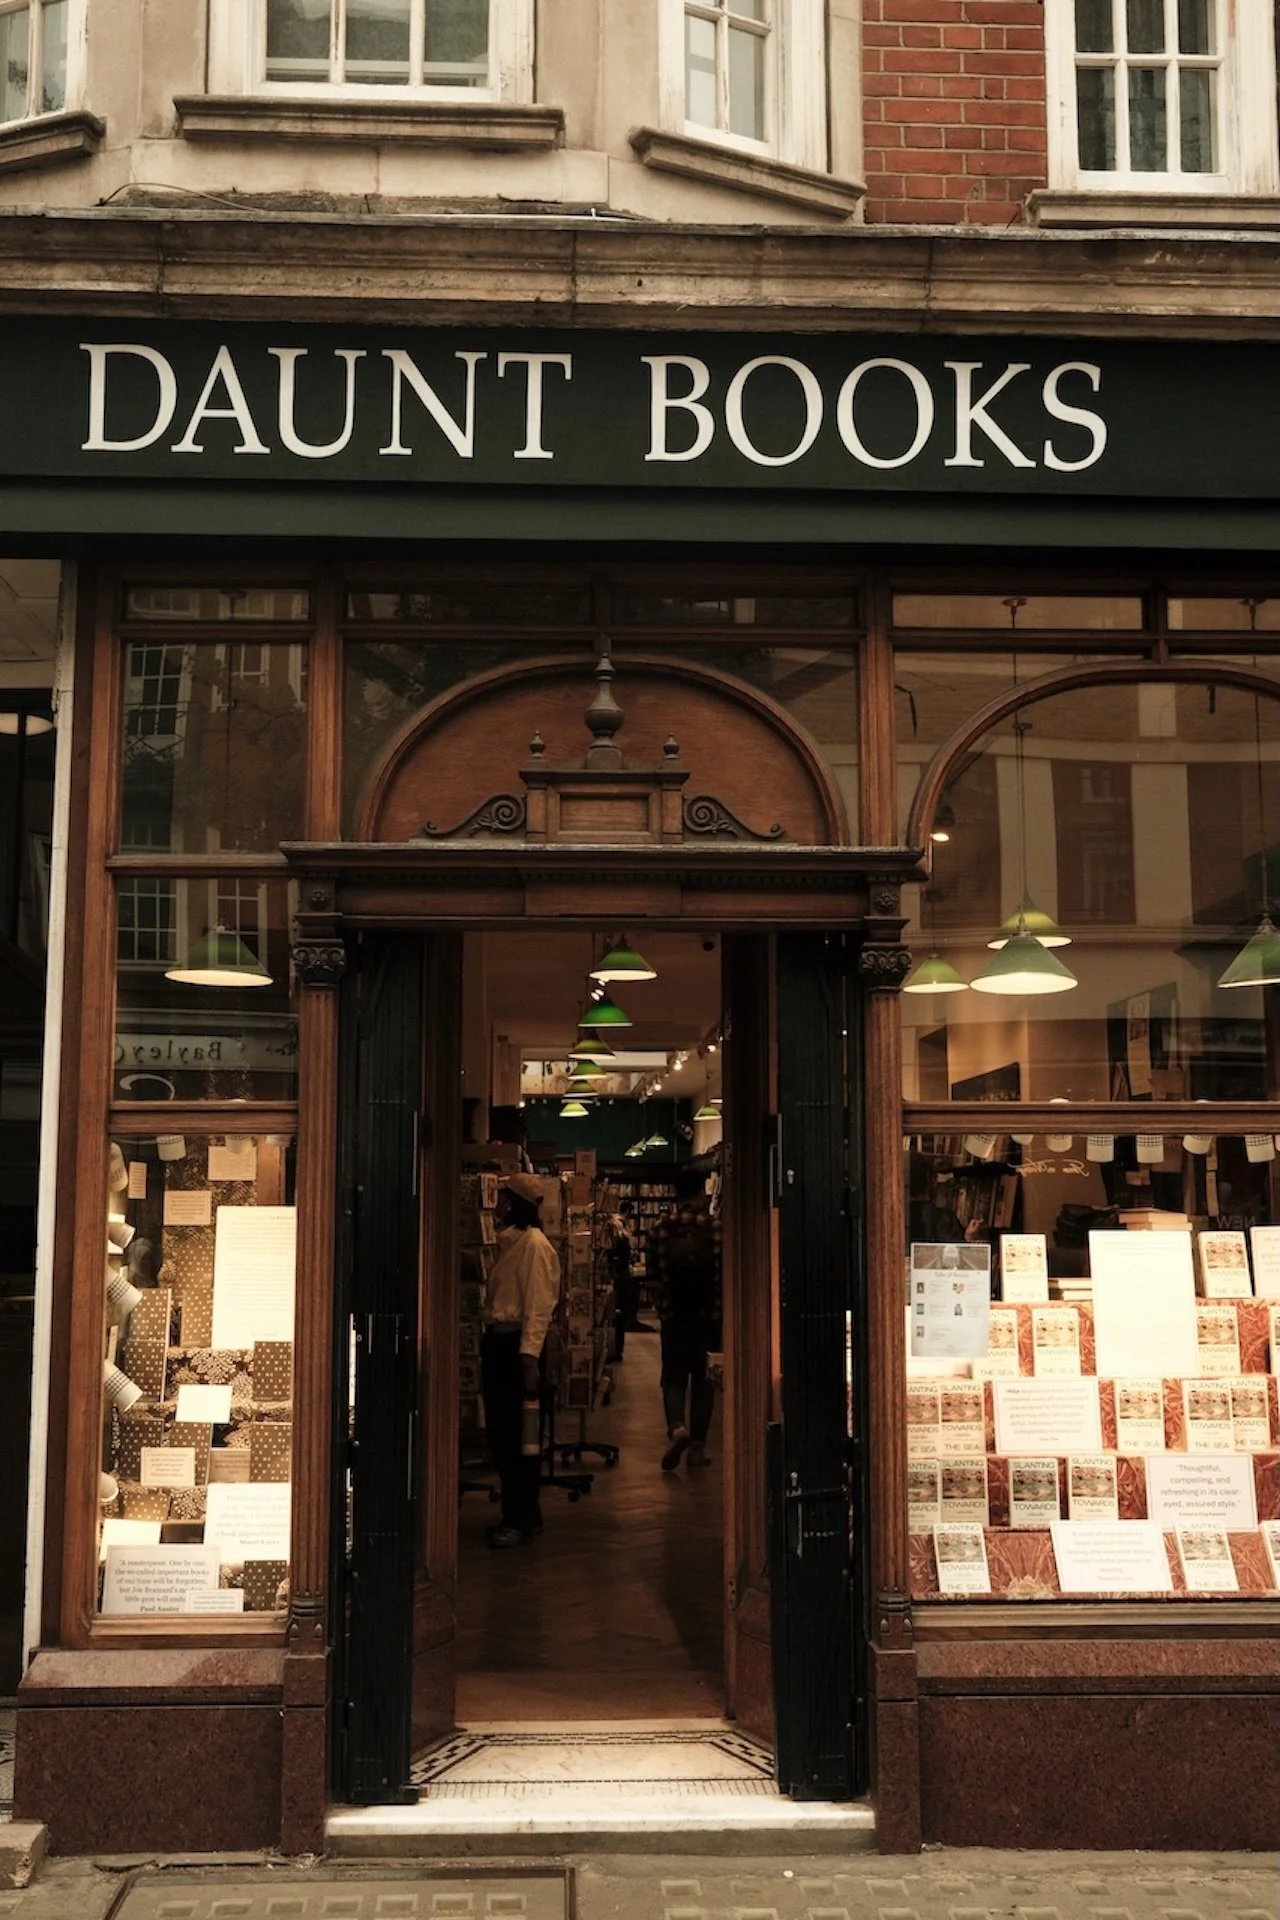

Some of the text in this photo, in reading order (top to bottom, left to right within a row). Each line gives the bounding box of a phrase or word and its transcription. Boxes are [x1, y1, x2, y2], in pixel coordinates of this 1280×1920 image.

[80, 342, 1109, 472] DAUNT BOOKS
[940, 1384, 981, 1392] SLANTING
[1230, 1380, 1265, 1388] LANTING
[944, 1443, 981, 1451] THE SEA
[1014, 1461, 1056, 1469] SLANTING
[1072, 1458, 1113, 1466] SLANTING
[1014, 1503, 1057, 1511] TOWARDS
[1073, 1499, 1115, 1507] TOWARDS
[157, 1568, 189, 1577] important
